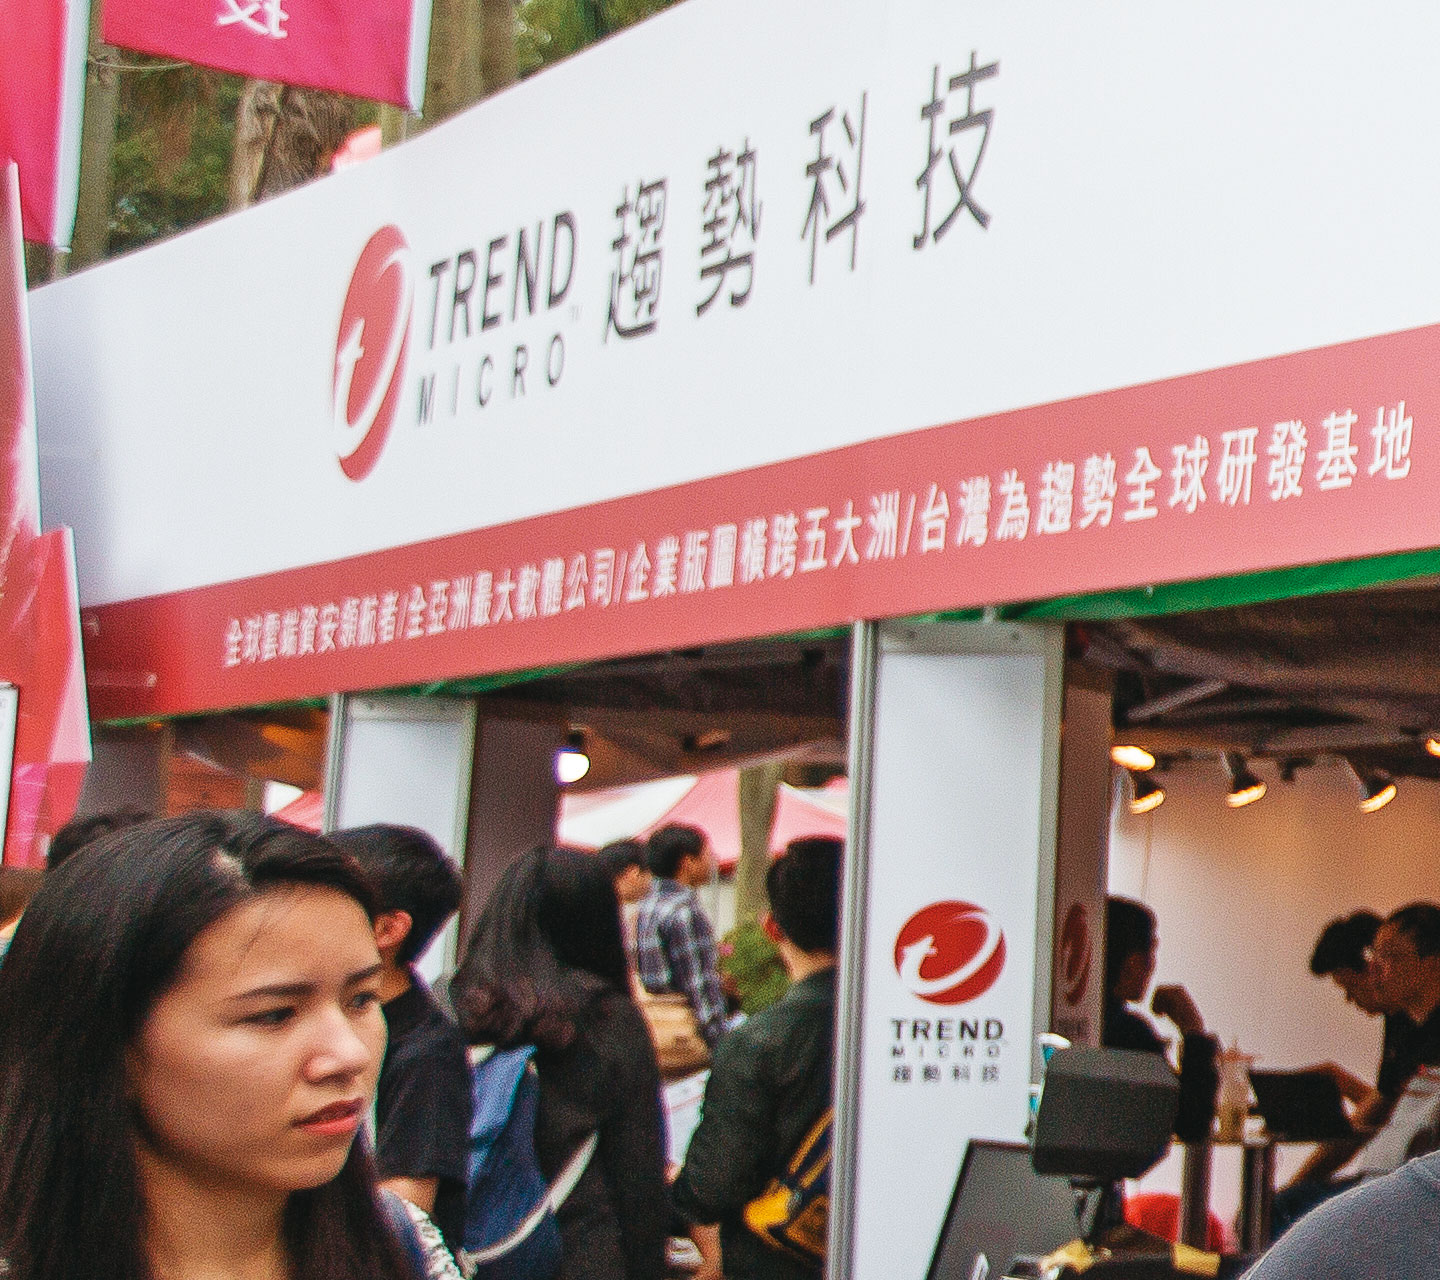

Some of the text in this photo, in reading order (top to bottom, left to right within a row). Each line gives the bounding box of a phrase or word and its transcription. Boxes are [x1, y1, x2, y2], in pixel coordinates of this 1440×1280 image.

[603, 48, 1001, 347] 趨勢科技
[426, 209, 579, 352] TREND
[416, 332, 567, 428] MICRO
[890, 1018, 1005, 1041] TREND
